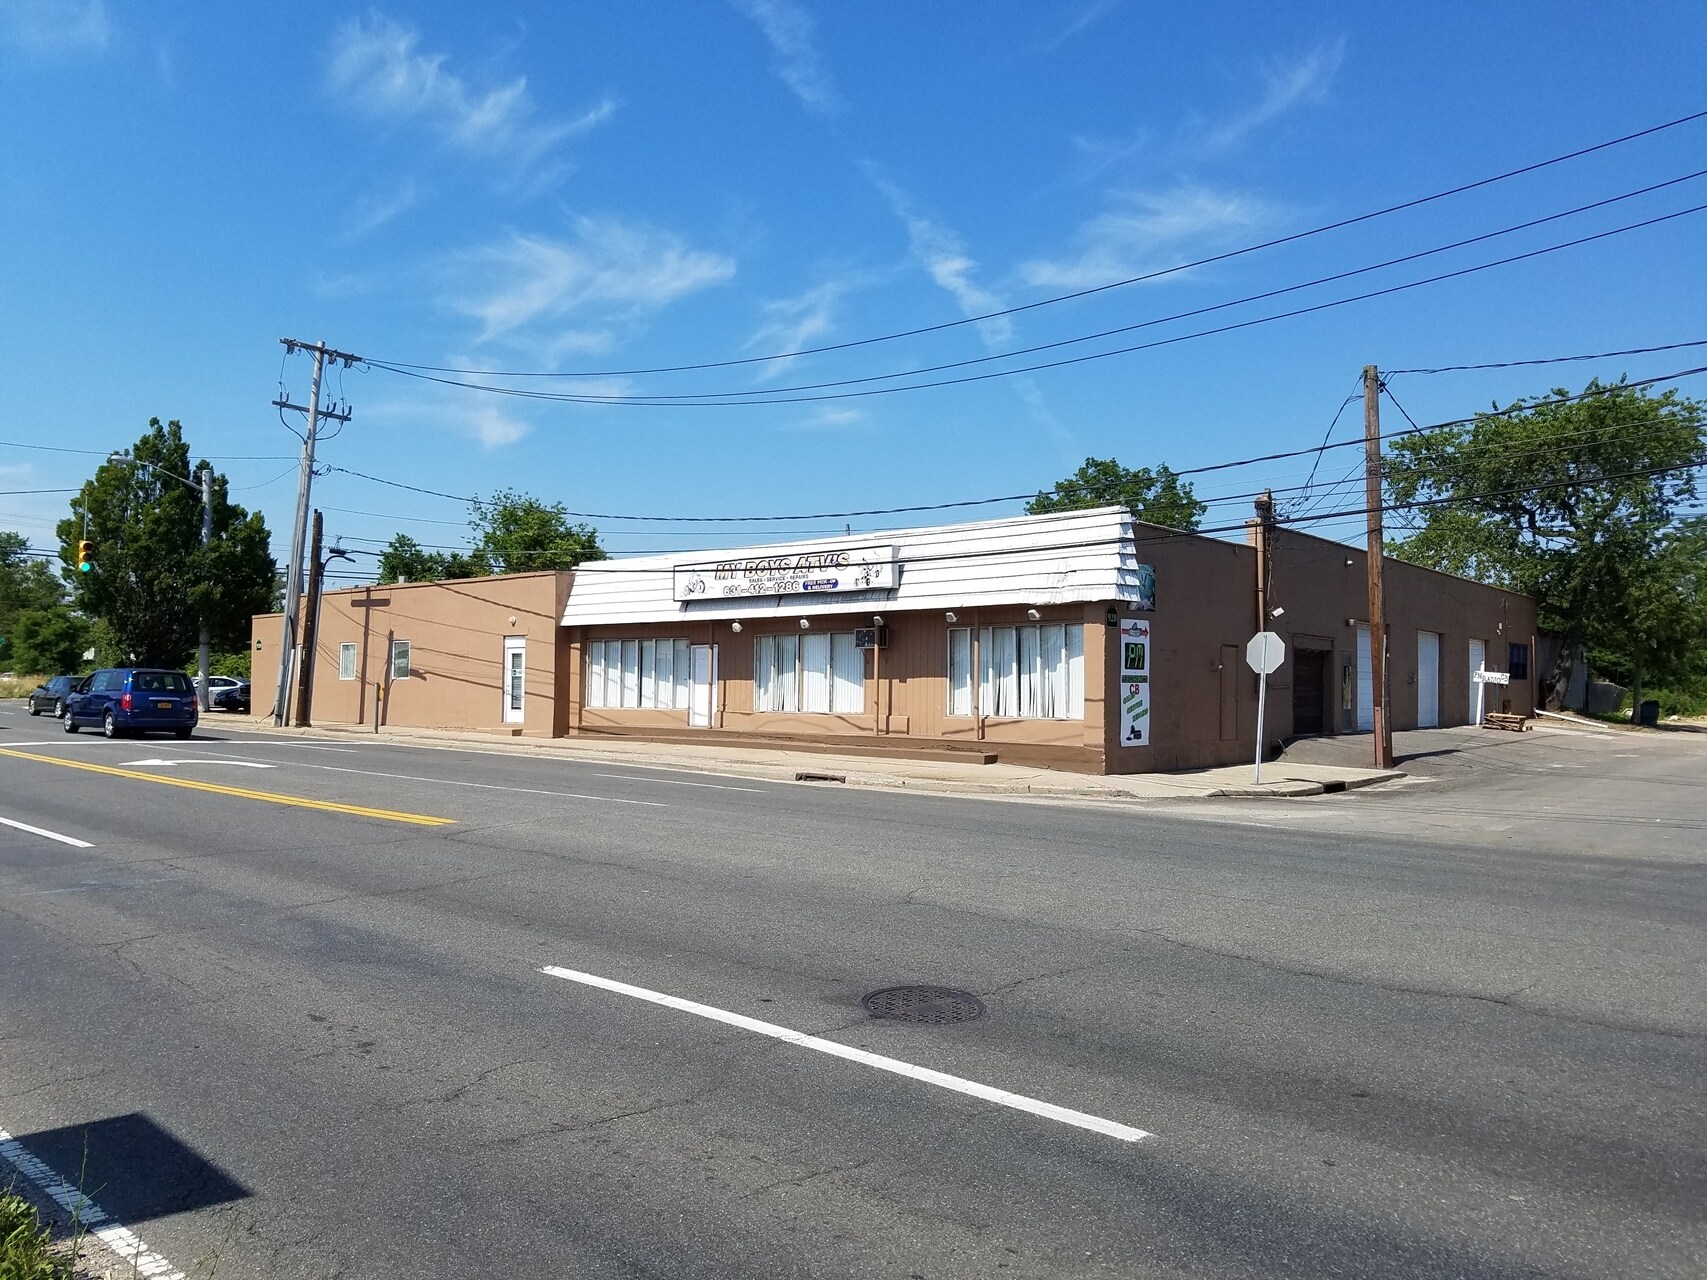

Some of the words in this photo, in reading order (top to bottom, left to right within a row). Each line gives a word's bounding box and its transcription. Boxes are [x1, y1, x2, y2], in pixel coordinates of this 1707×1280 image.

[715, 562, 742, 580] MY
[744, 558, 791, 578] BOYS
[793, 552, 850, 574] ATV'S
[723, 581, 800, 596] 631-412-1286
[1127, 644, 1144, 668] PM
[1129, 683, 1140, 695] CB
